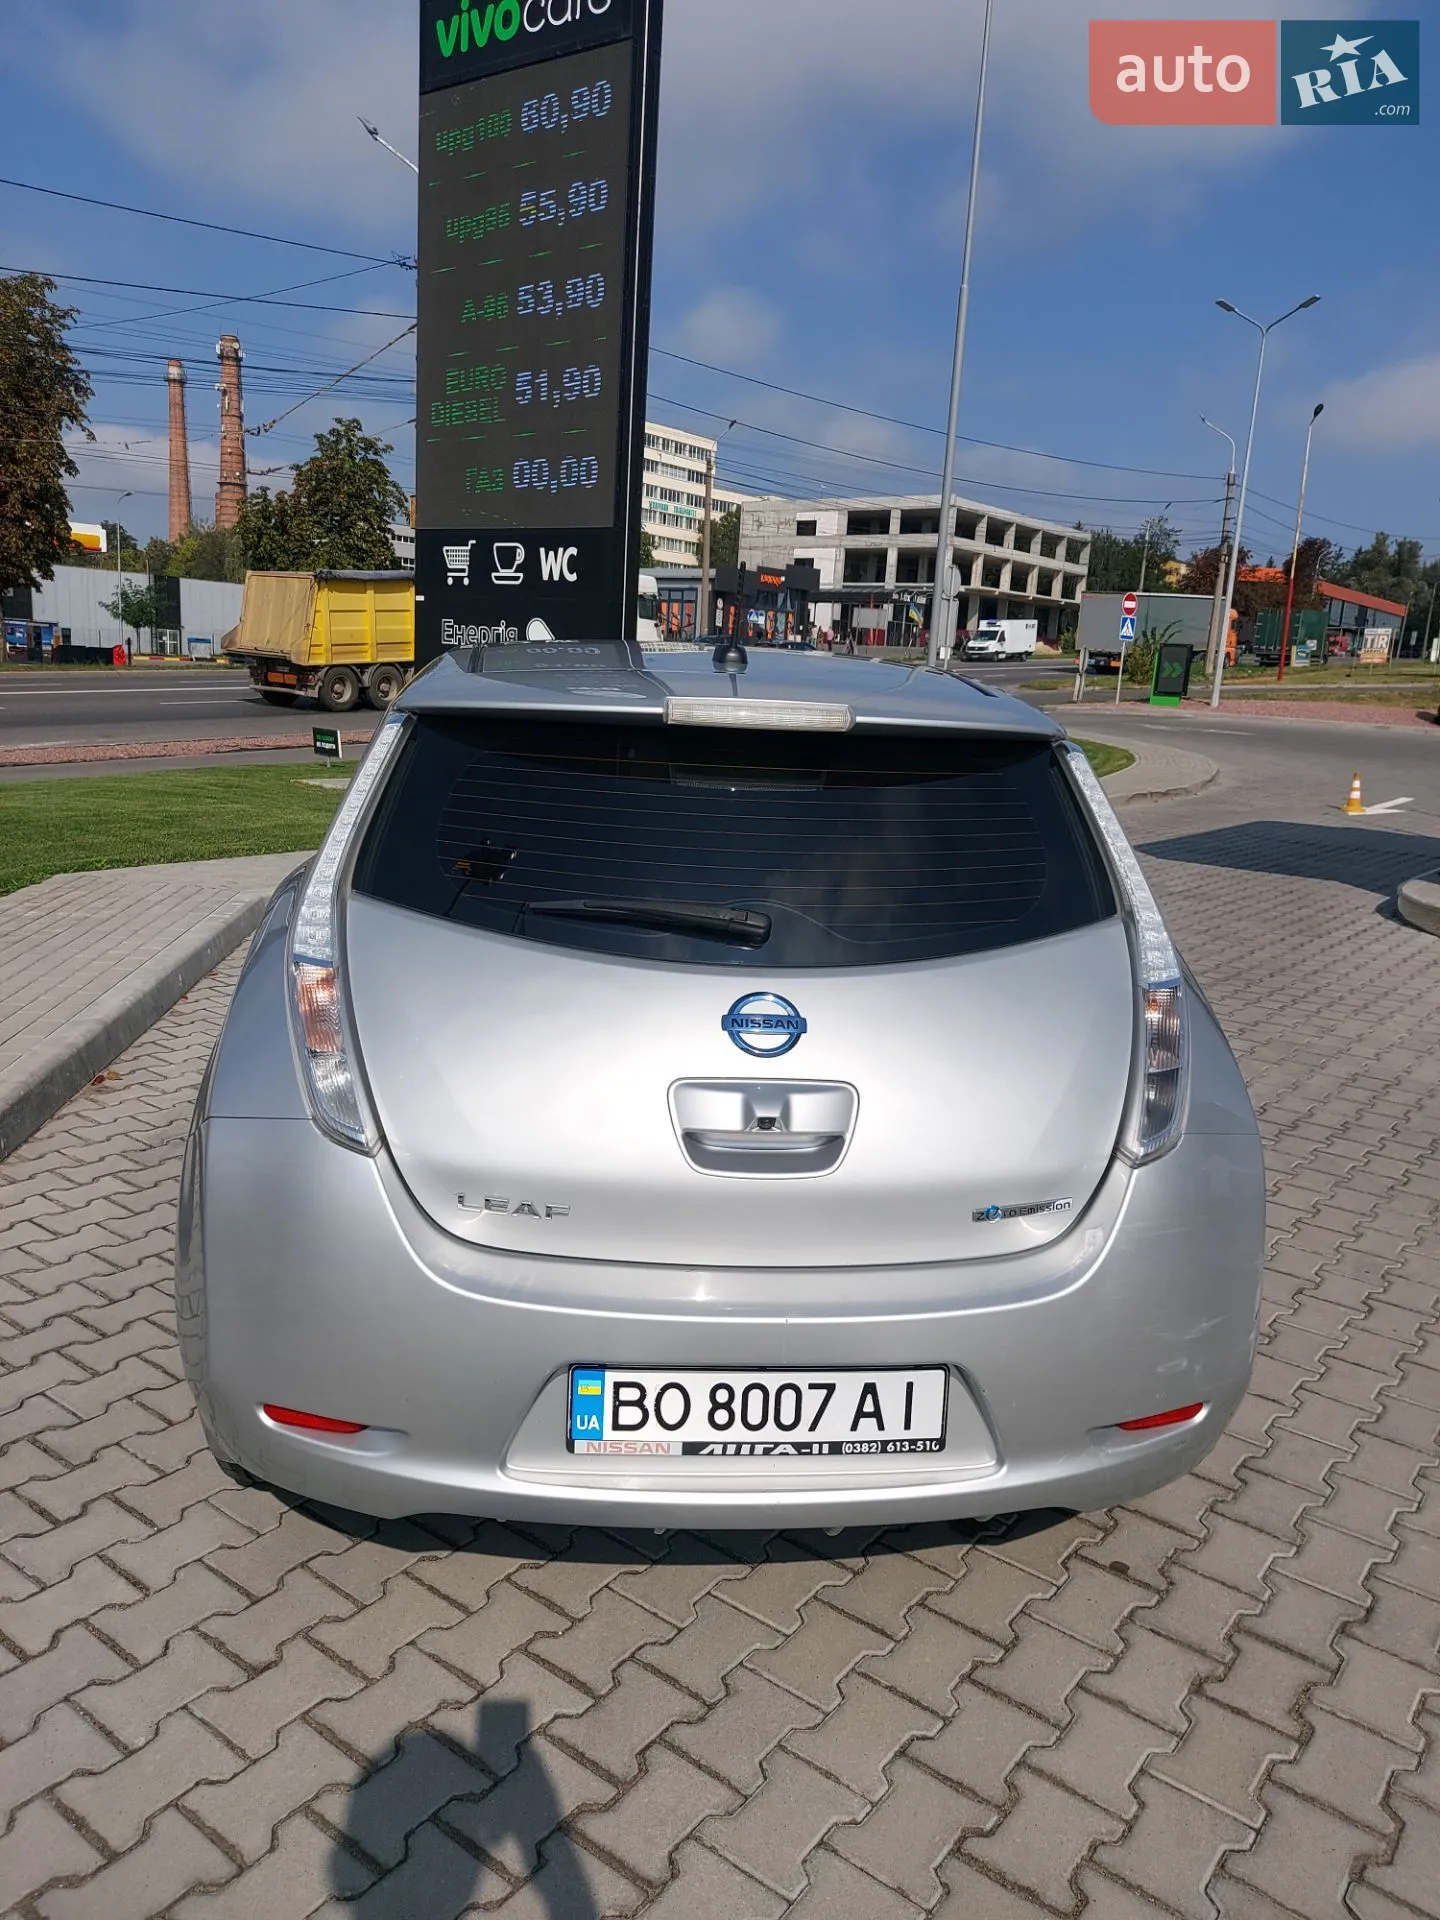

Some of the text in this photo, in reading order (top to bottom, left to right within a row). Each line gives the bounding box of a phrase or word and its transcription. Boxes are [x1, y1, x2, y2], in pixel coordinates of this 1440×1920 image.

[520, 80, 612, 135] 60,90
[519, 179, 608, 226] 55,90
[516, 272, 605, 320] 53,90
[446, 364, 602, 408] EURO 51,90
[431, 397, 506, 427] DIESEL
[512, 455, 599, 496] 00,00
[539, 546, 578, 582] WC
[1366, 635, 1388, 649] TIR
[731, 1018, 799, 1029] NISSAN
[457, 1192, 571, 1220] LEAF
[576, 1414, 600, 1431] UA
[611, 1381, 914, 1432] BO 8007 AI
[586, 1441, 671, 1454] NISSAN
[841, 1441, 882, 1455] (0382)
